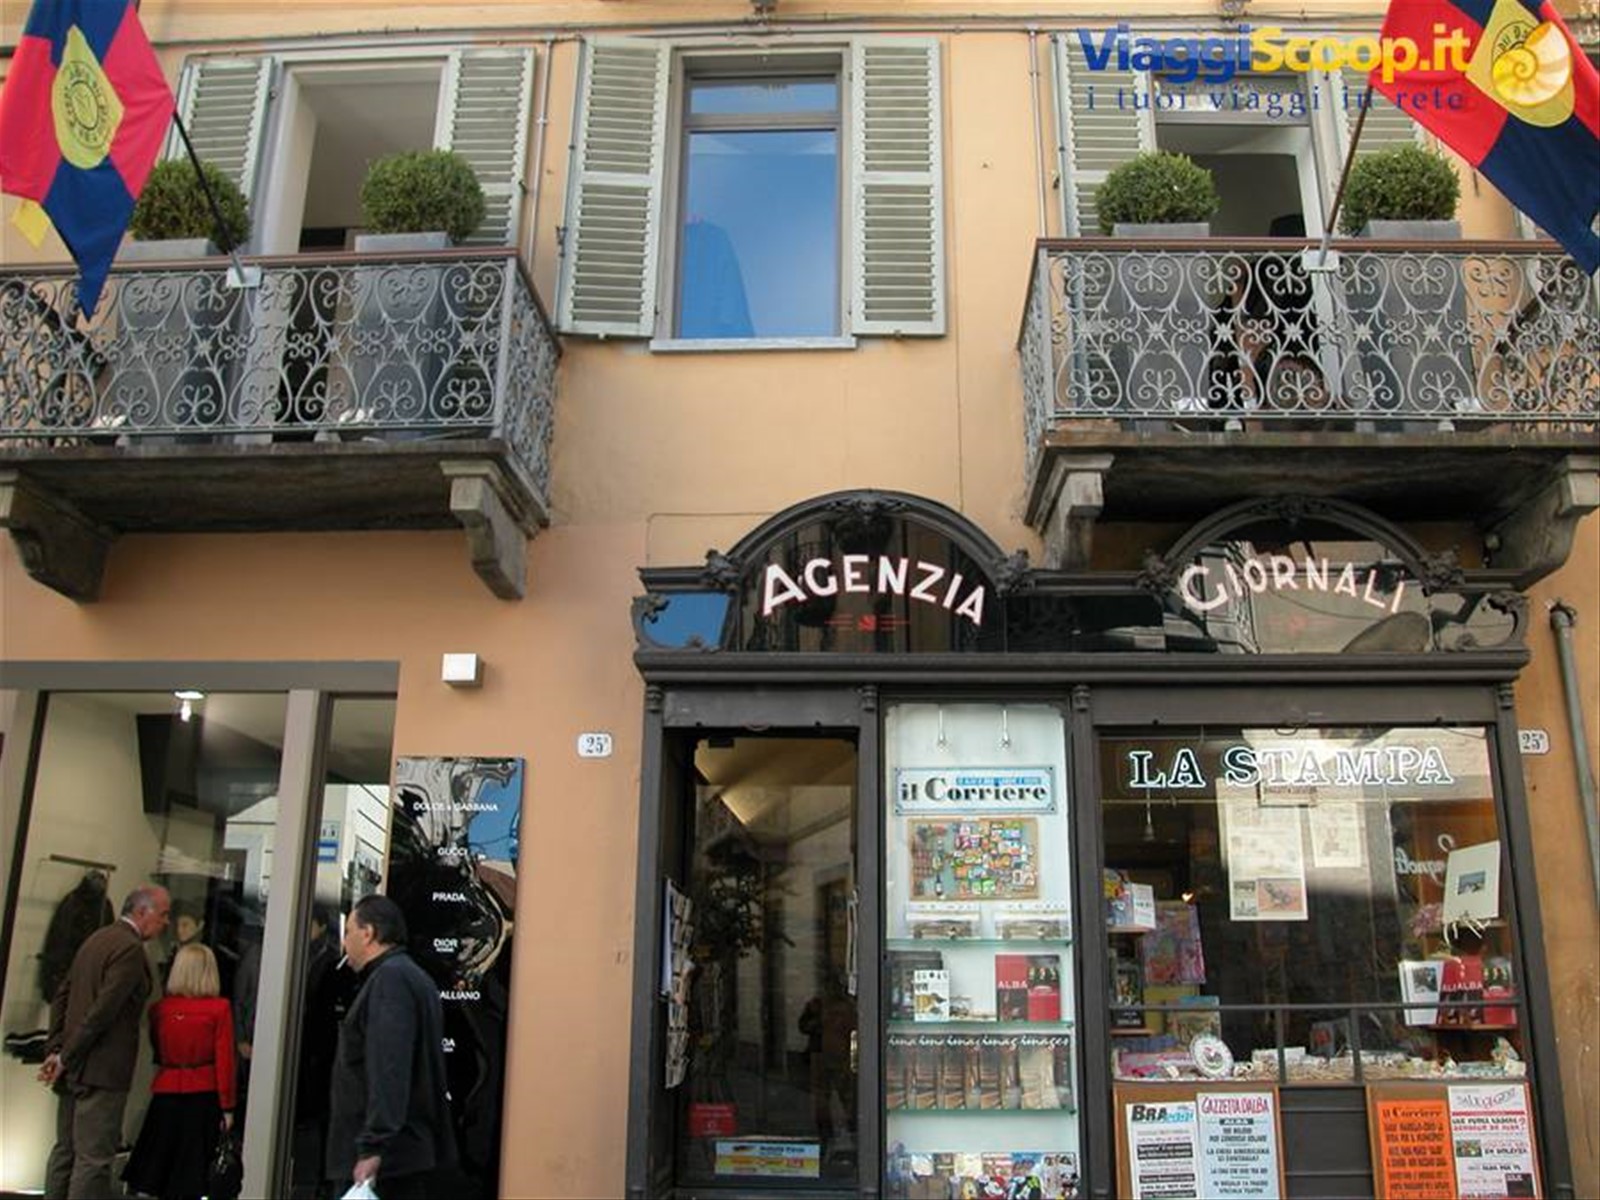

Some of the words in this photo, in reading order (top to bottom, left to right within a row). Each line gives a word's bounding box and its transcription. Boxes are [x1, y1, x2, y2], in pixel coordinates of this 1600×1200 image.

[1180, 554, 1405, 614] GIORNALI
[762, 554, 985, 627] AGENZIA
[1129, 749, 1206, 788] LA
[1224, 747, 1455, 787] STAMPA
[901, 782, 917, 800] il
[925, 777, 1046, 801] Corriere
[437, 846, 468, 856] GUCCI
[432, 891, 466, 901] PRADA
[433, 938, 458, 948] DIOR
[1457, 980, 1484, 990] ALBA
[440, 990, 481, 1000] ALLIANO
